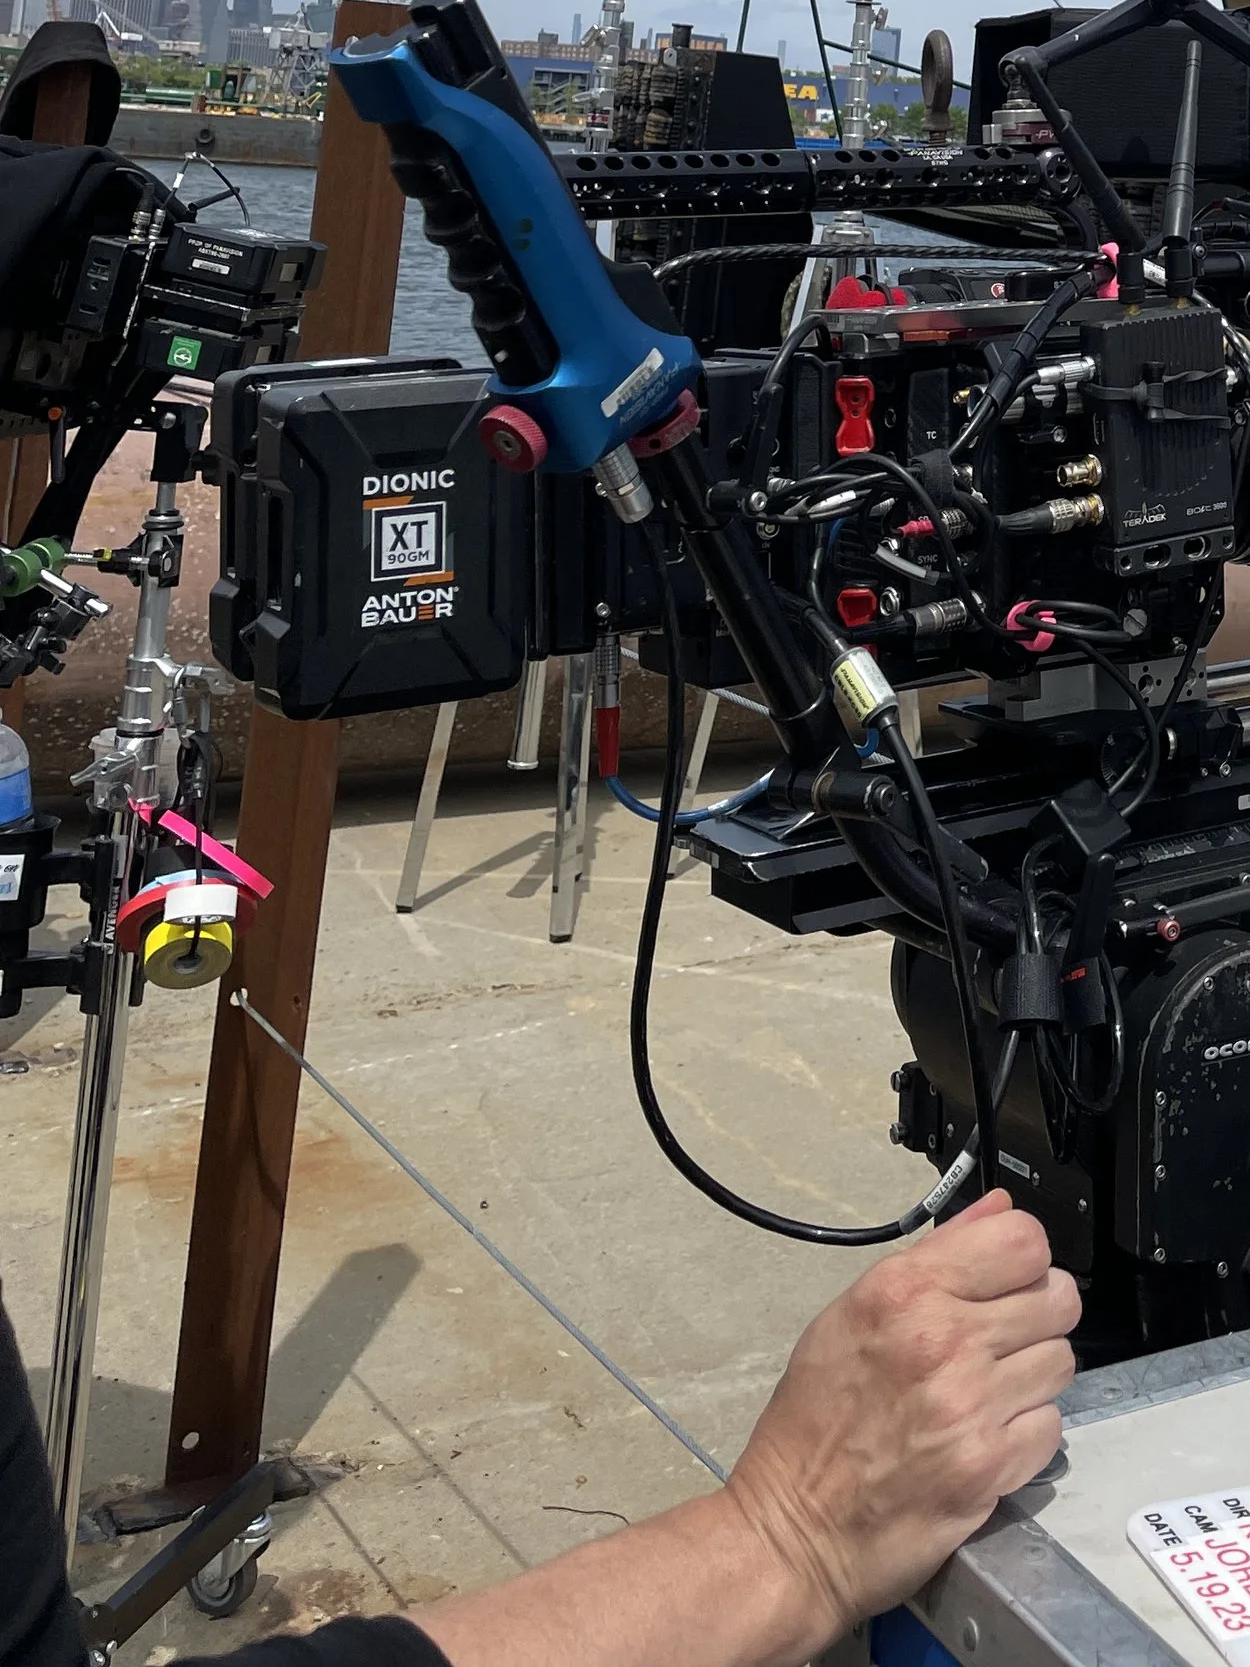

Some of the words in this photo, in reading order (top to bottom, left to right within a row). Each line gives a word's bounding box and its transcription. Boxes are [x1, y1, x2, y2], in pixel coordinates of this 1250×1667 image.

[926, 430, 937, 440] TC
[362, 468, 456, 497] DIONIC
[1122, 512, 1167, 528] TERADEK
[388, 519, 429, 553] XT
[387, 548, 430, 565] 90GM
[361, 585, 454, 612] ANTON
[360, 601, 454, 628] BAUER
[1143, 1512, 1183, 1547] DATE
[1184, 1505, 1218, 1534] CAM
